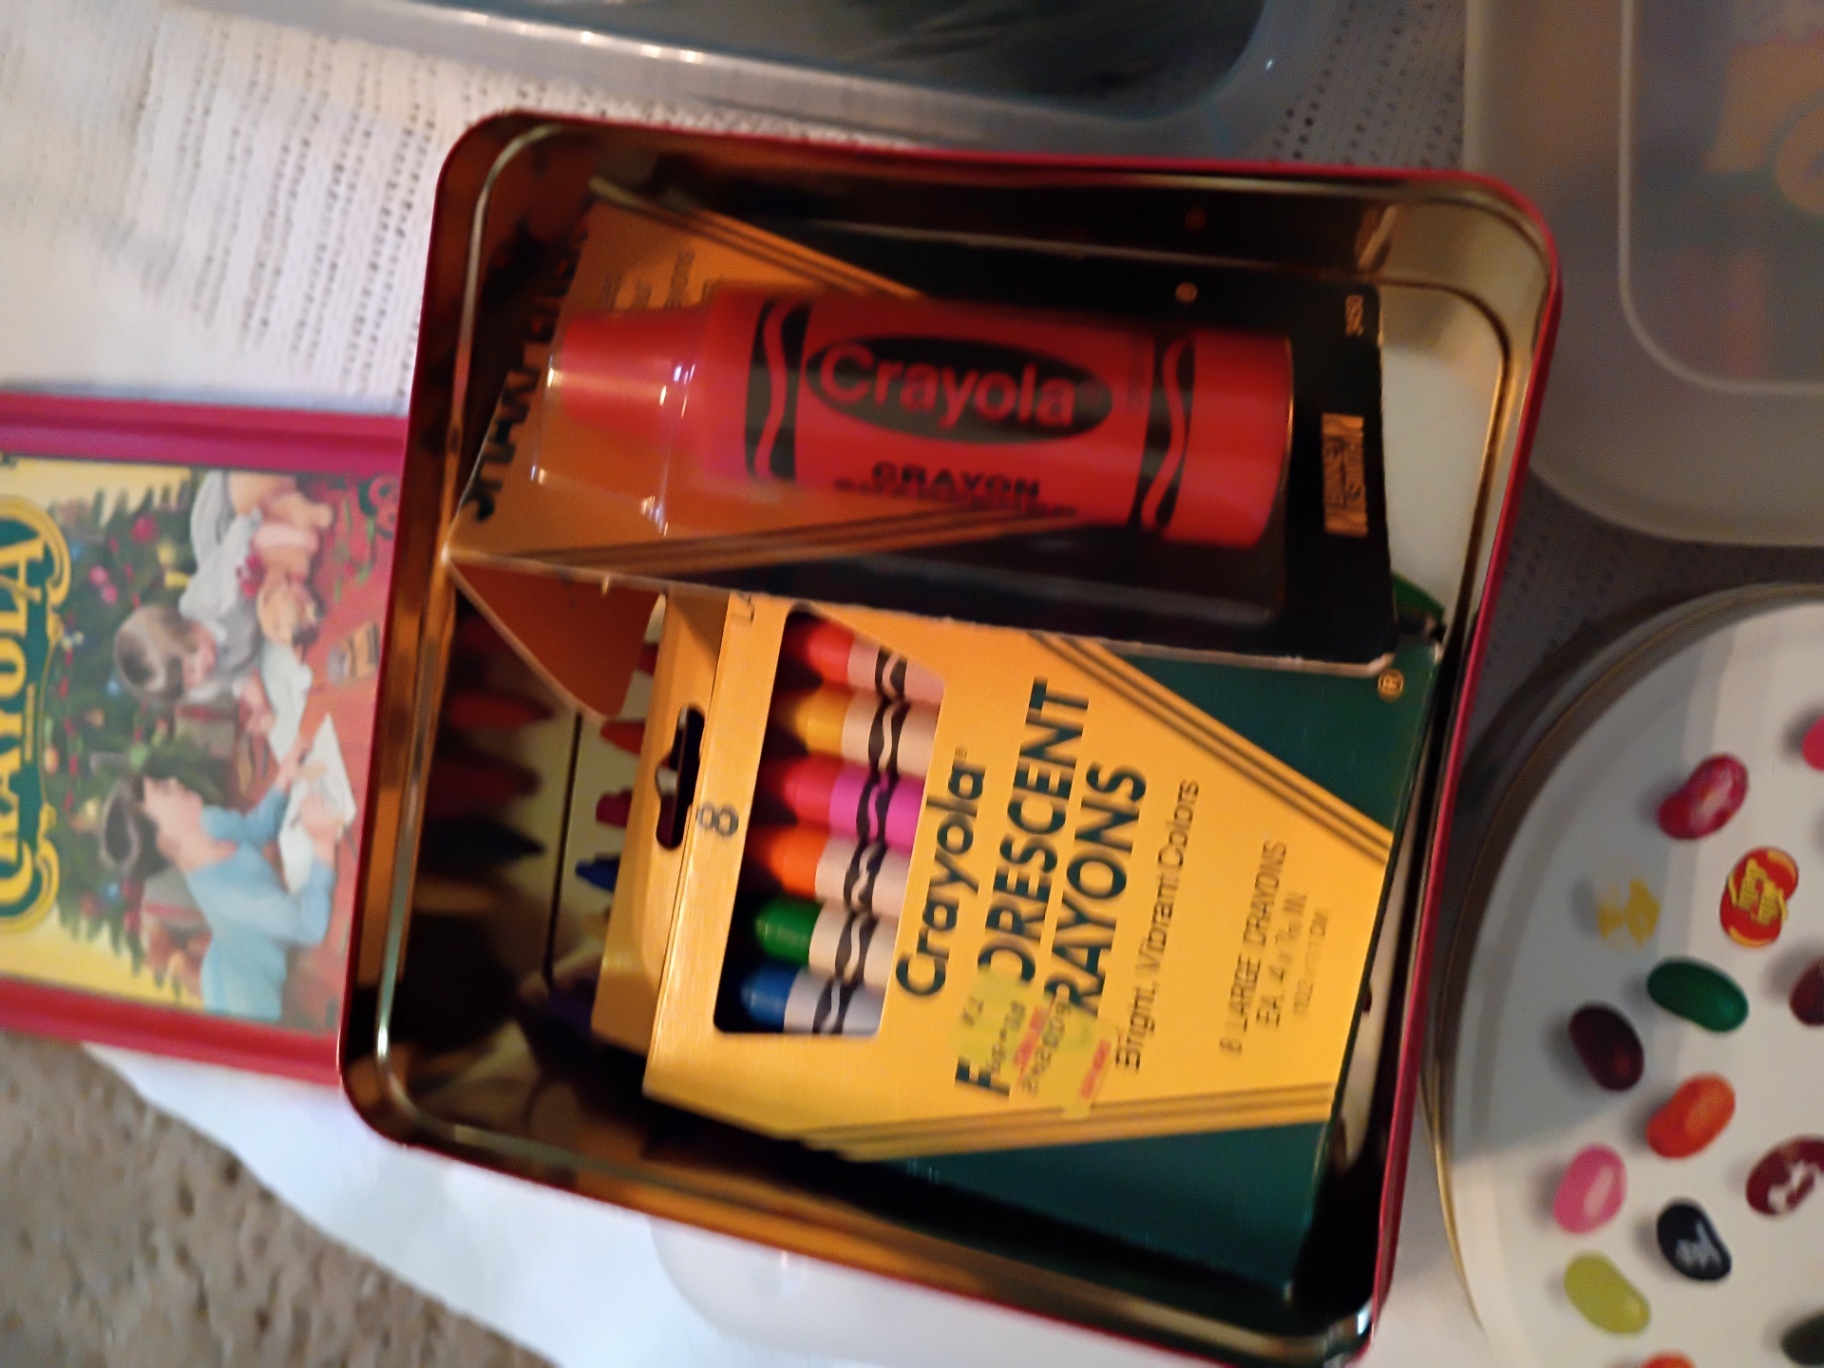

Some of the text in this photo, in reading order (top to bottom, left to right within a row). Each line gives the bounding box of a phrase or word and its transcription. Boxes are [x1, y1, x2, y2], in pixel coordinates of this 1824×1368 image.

[819, 343, 1076, 430] Crayola
[872, 460, 1041, 499] CRAYON
[696, 801, 740, 838] 8
[1157, 778, 1199, 868] Colors
[895, 757, 986, 998] Crayola
[954, 675, 1090, 1098] FORESCENT
[1043, 762, 1148, 1018] RAYONS
[1136, 873, 1180, 974] Vibrant
[1242, 839, 1287, 949] CRAYONS
[1225, 953, 1262, 1034] LARGE
